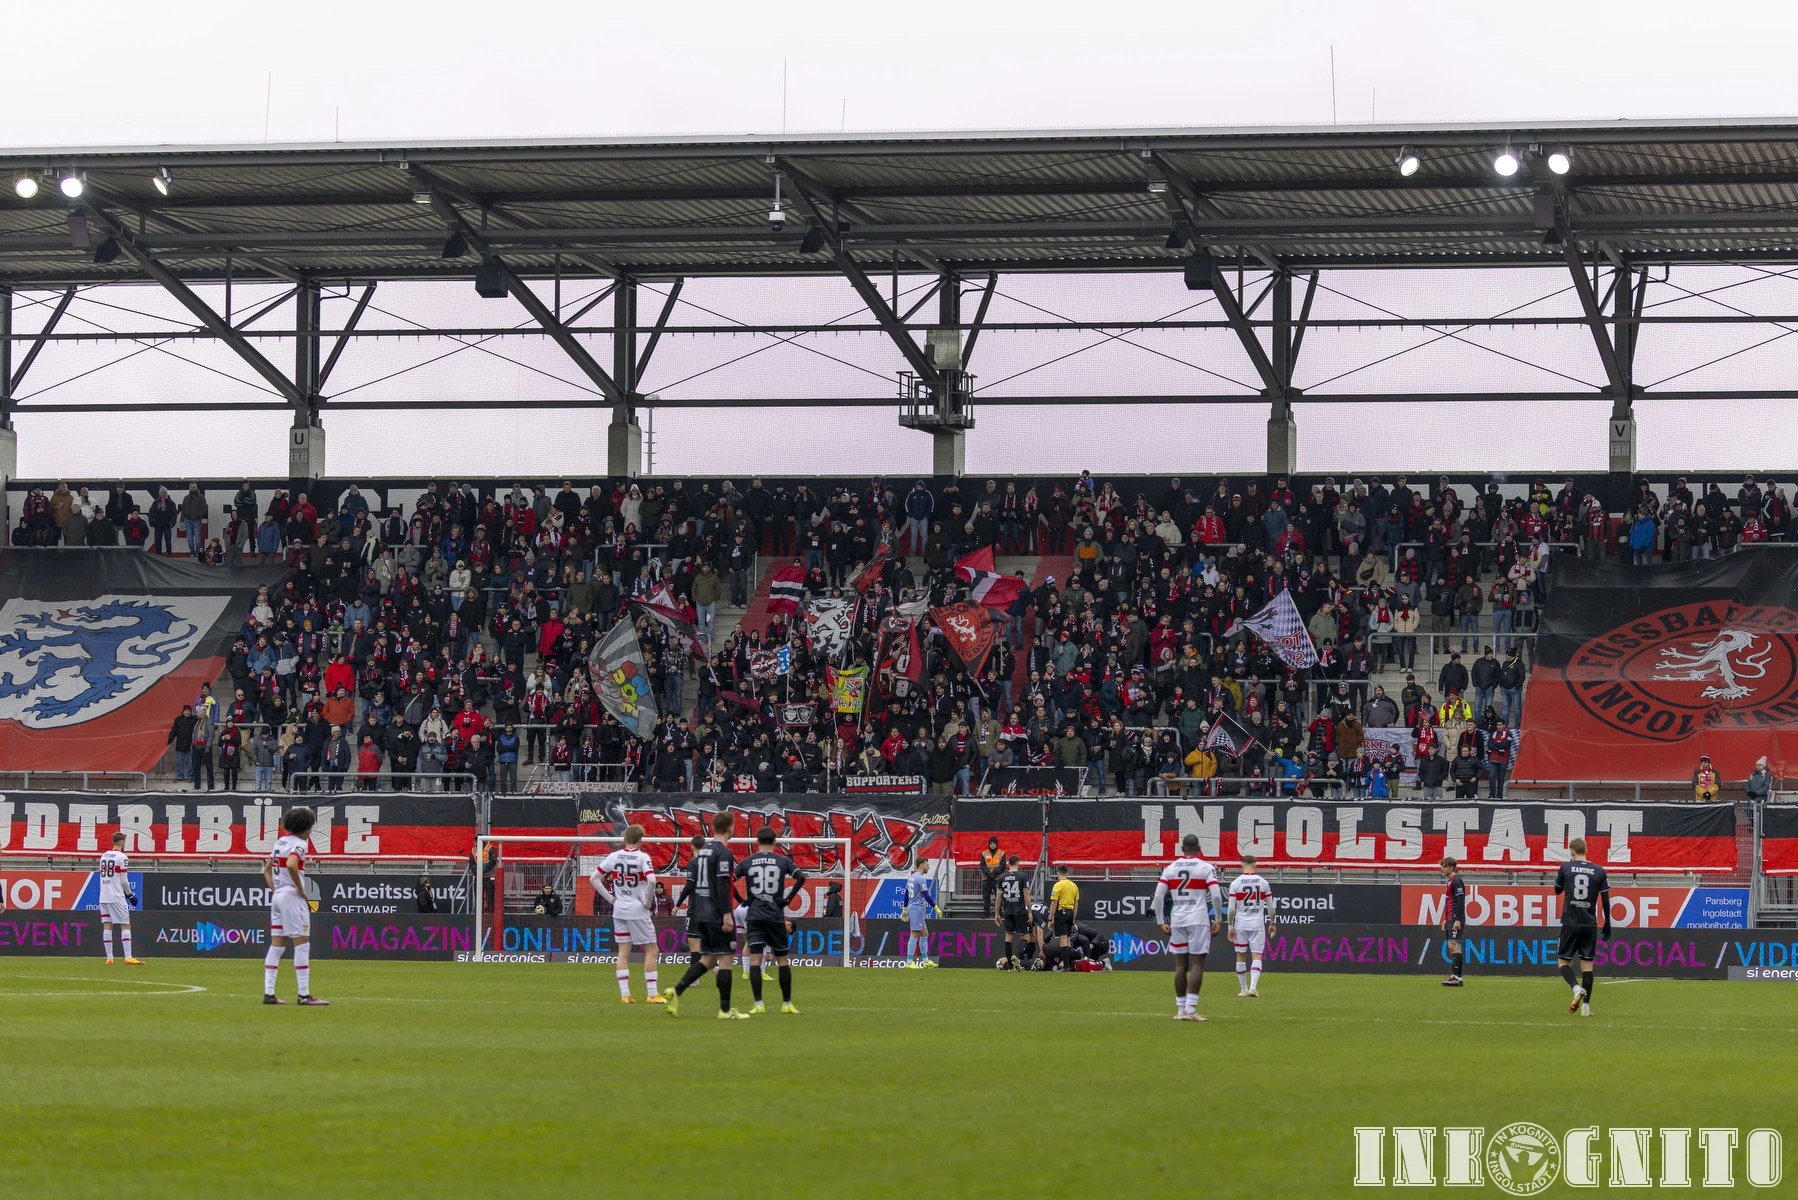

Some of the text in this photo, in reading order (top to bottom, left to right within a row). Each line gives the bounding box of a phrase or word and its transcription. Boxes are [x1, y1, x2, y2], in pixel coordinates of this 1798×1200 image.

[294, 432, 304, 445] U
[1615, 424, 1626, 437] V
[847, 775, 920, 787] SUPPORTERS
[0, 795, 380, 854] DTRIBÜNE
[1141, 805, 1644, 863] INGOLSTADT
[100, 859, 116, 878] 38
[614, 862, 639, 888] 35
[696, 857, 709, 888] 11
[748, 865, 781, 895] 38
[0, 878, 63, 910] OF
[1001, 880, 1021, 899] 34
[1177, 869, 1190, 896] 2
[1573, 874, 1590, 900] 8
[1243, 885, 1260, 907] 21
[1417, 885, 1564, 926] MÖBEL
[1705, 897, 1743, 908] Parsberg
[1686, 921, 1743, 929] moebelhof.de
[1702, 909, 1743, 919] Ingolstadt
[156, 927, 265, 944] AZUBI MOVIE
[333, 925, 471, 951] MAGAZIN
[503, 927, 611, 952] ONLINE
[1262, 936, 1408, 963] MAGAZIN
[1593, 940, 1706, 967] SOCIAL
[1746, 967, 1759, 978] si
